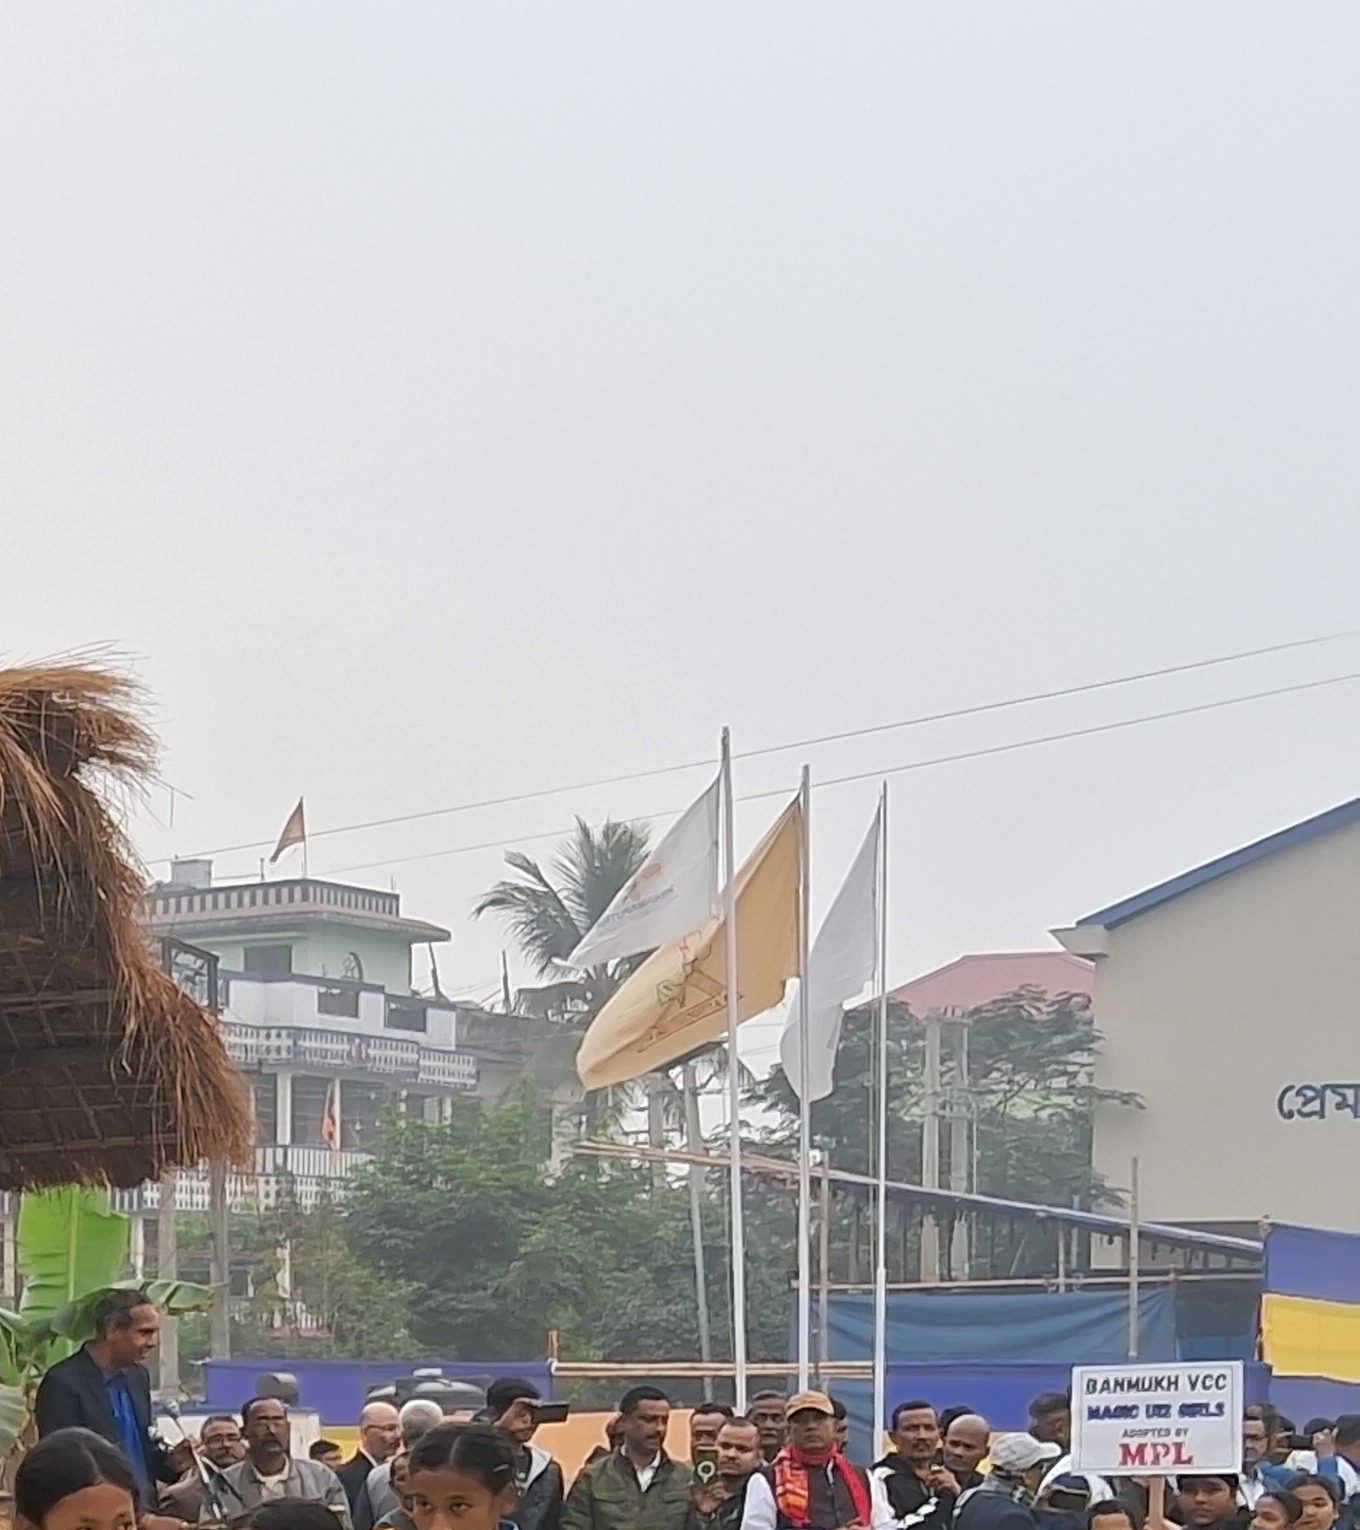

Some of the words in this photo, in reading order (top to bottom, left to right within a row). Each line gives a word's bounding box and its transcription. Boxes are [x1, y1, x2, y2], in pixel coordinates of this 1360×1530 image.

[1085, 1375, 1179, 1395] BANMUKH
[1188, 1374, 1227, 1391] VCC
[1175, 1428, 1189, 1437] BY
[1119, 1443, 1193, 1466] MPL
